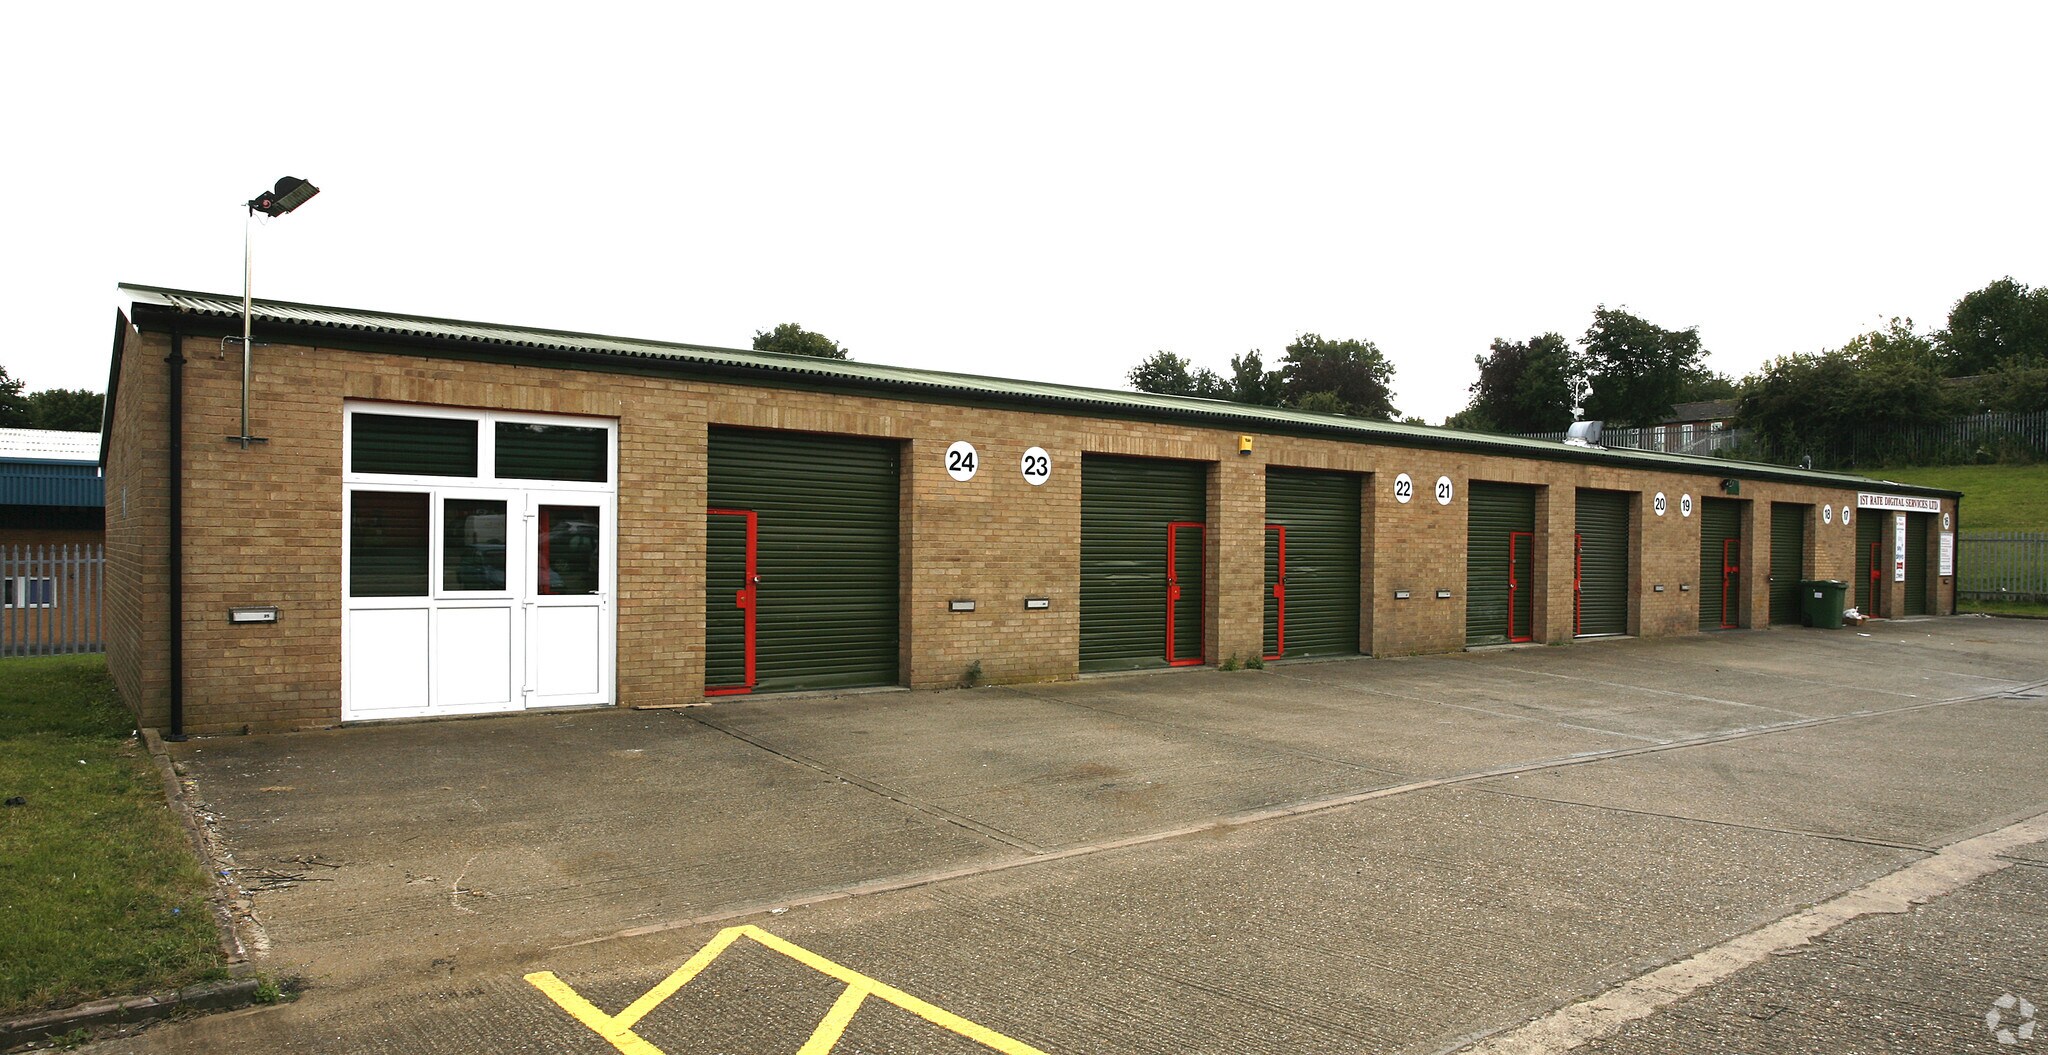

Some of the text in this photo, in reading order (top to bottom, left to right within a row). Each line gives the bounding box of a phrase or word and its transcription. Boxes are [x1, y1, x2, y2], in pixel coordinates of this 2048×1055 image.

[949, 450, 974, 472] 24
[1024, 455, 1048, 476] 23
[1396, 480, 1410, 496] 22
[1438, 483, 1450, 498] 21
[1656, 498, 1664, 510] 20
[1682, 500, 1690, 512] 19
[1860, 495, 1938, 510] 1ST RATE DIGITAL SERVICES LTD
[1824, 508, 1831, 520] 18
[1844, 510, 1848, 520] 17
